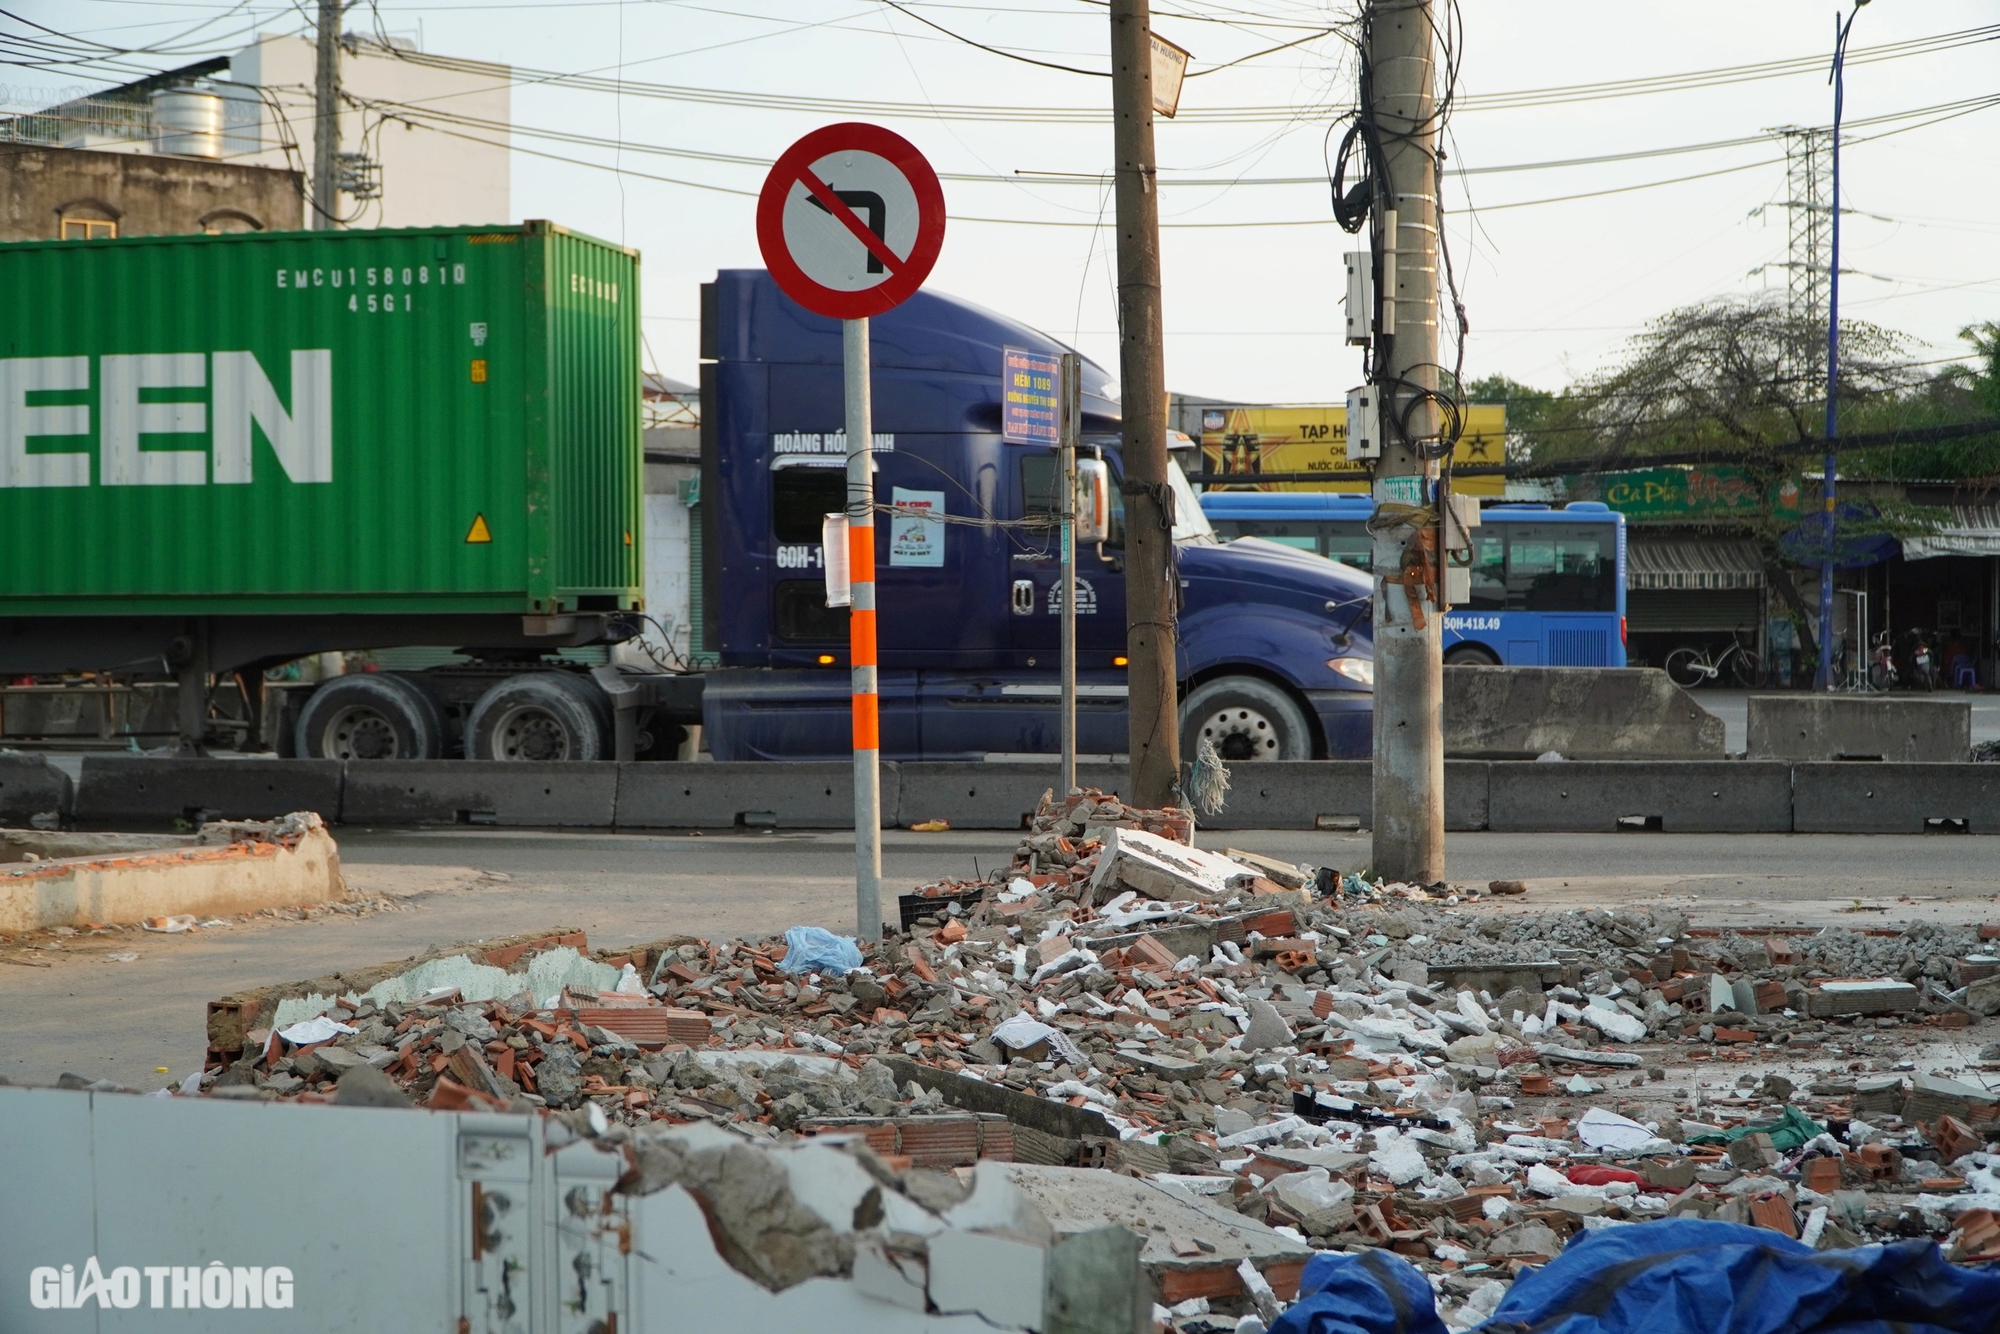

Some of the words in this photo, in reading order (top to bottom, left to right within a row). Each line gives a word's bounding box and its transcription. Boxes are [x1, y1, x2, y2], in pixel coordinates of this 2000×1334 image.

[348, 293, 411, 312] 45G1
[1033, 376, 1051, 391] 1089
[773, 429, 821, 453] HOÀNG
[1300, 425, 1329, 443] TẠP
[776, 545, 825, 569] 60H-1
[1443, 617, 1500, 631] 50H-418.49
